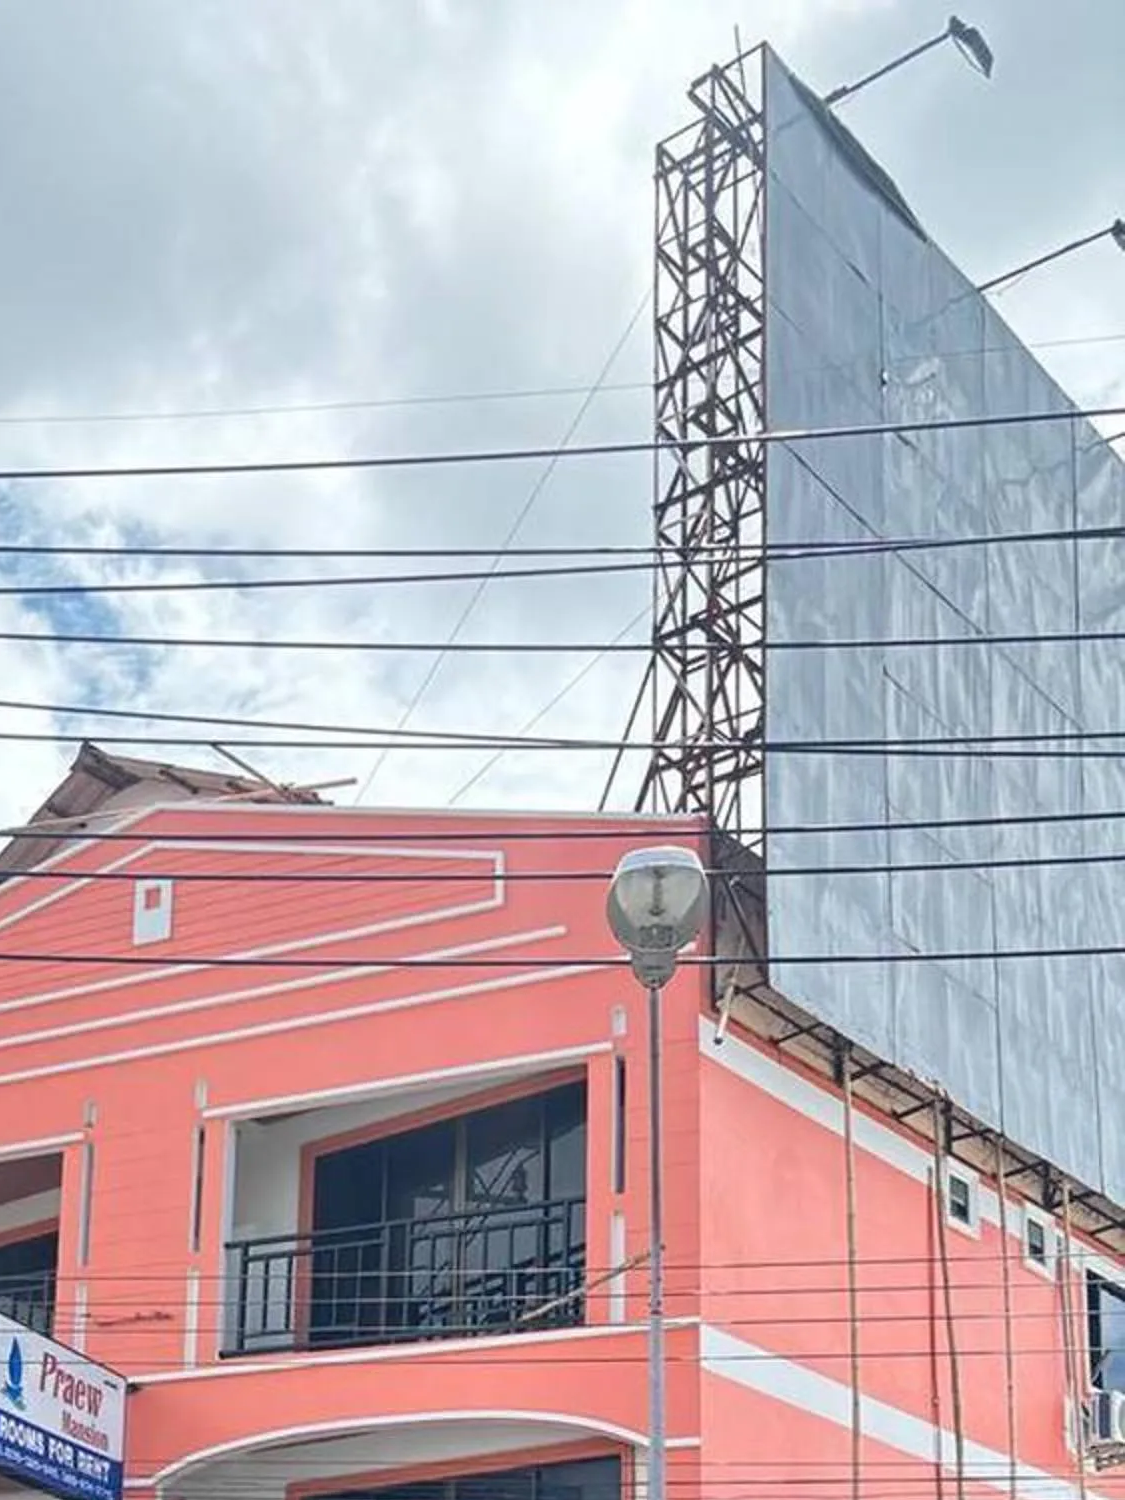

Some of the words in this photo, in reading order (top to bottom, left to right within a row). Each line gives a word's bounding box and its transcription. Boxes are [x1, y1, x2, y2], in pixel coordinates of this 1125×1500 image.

[39, 1351, 104, 1417] Praew
[61, 1409, 109, 1451] Mansion
[48, 1436, 74, 1469] FOR
[76, 1449, 111, 1483] RENT
